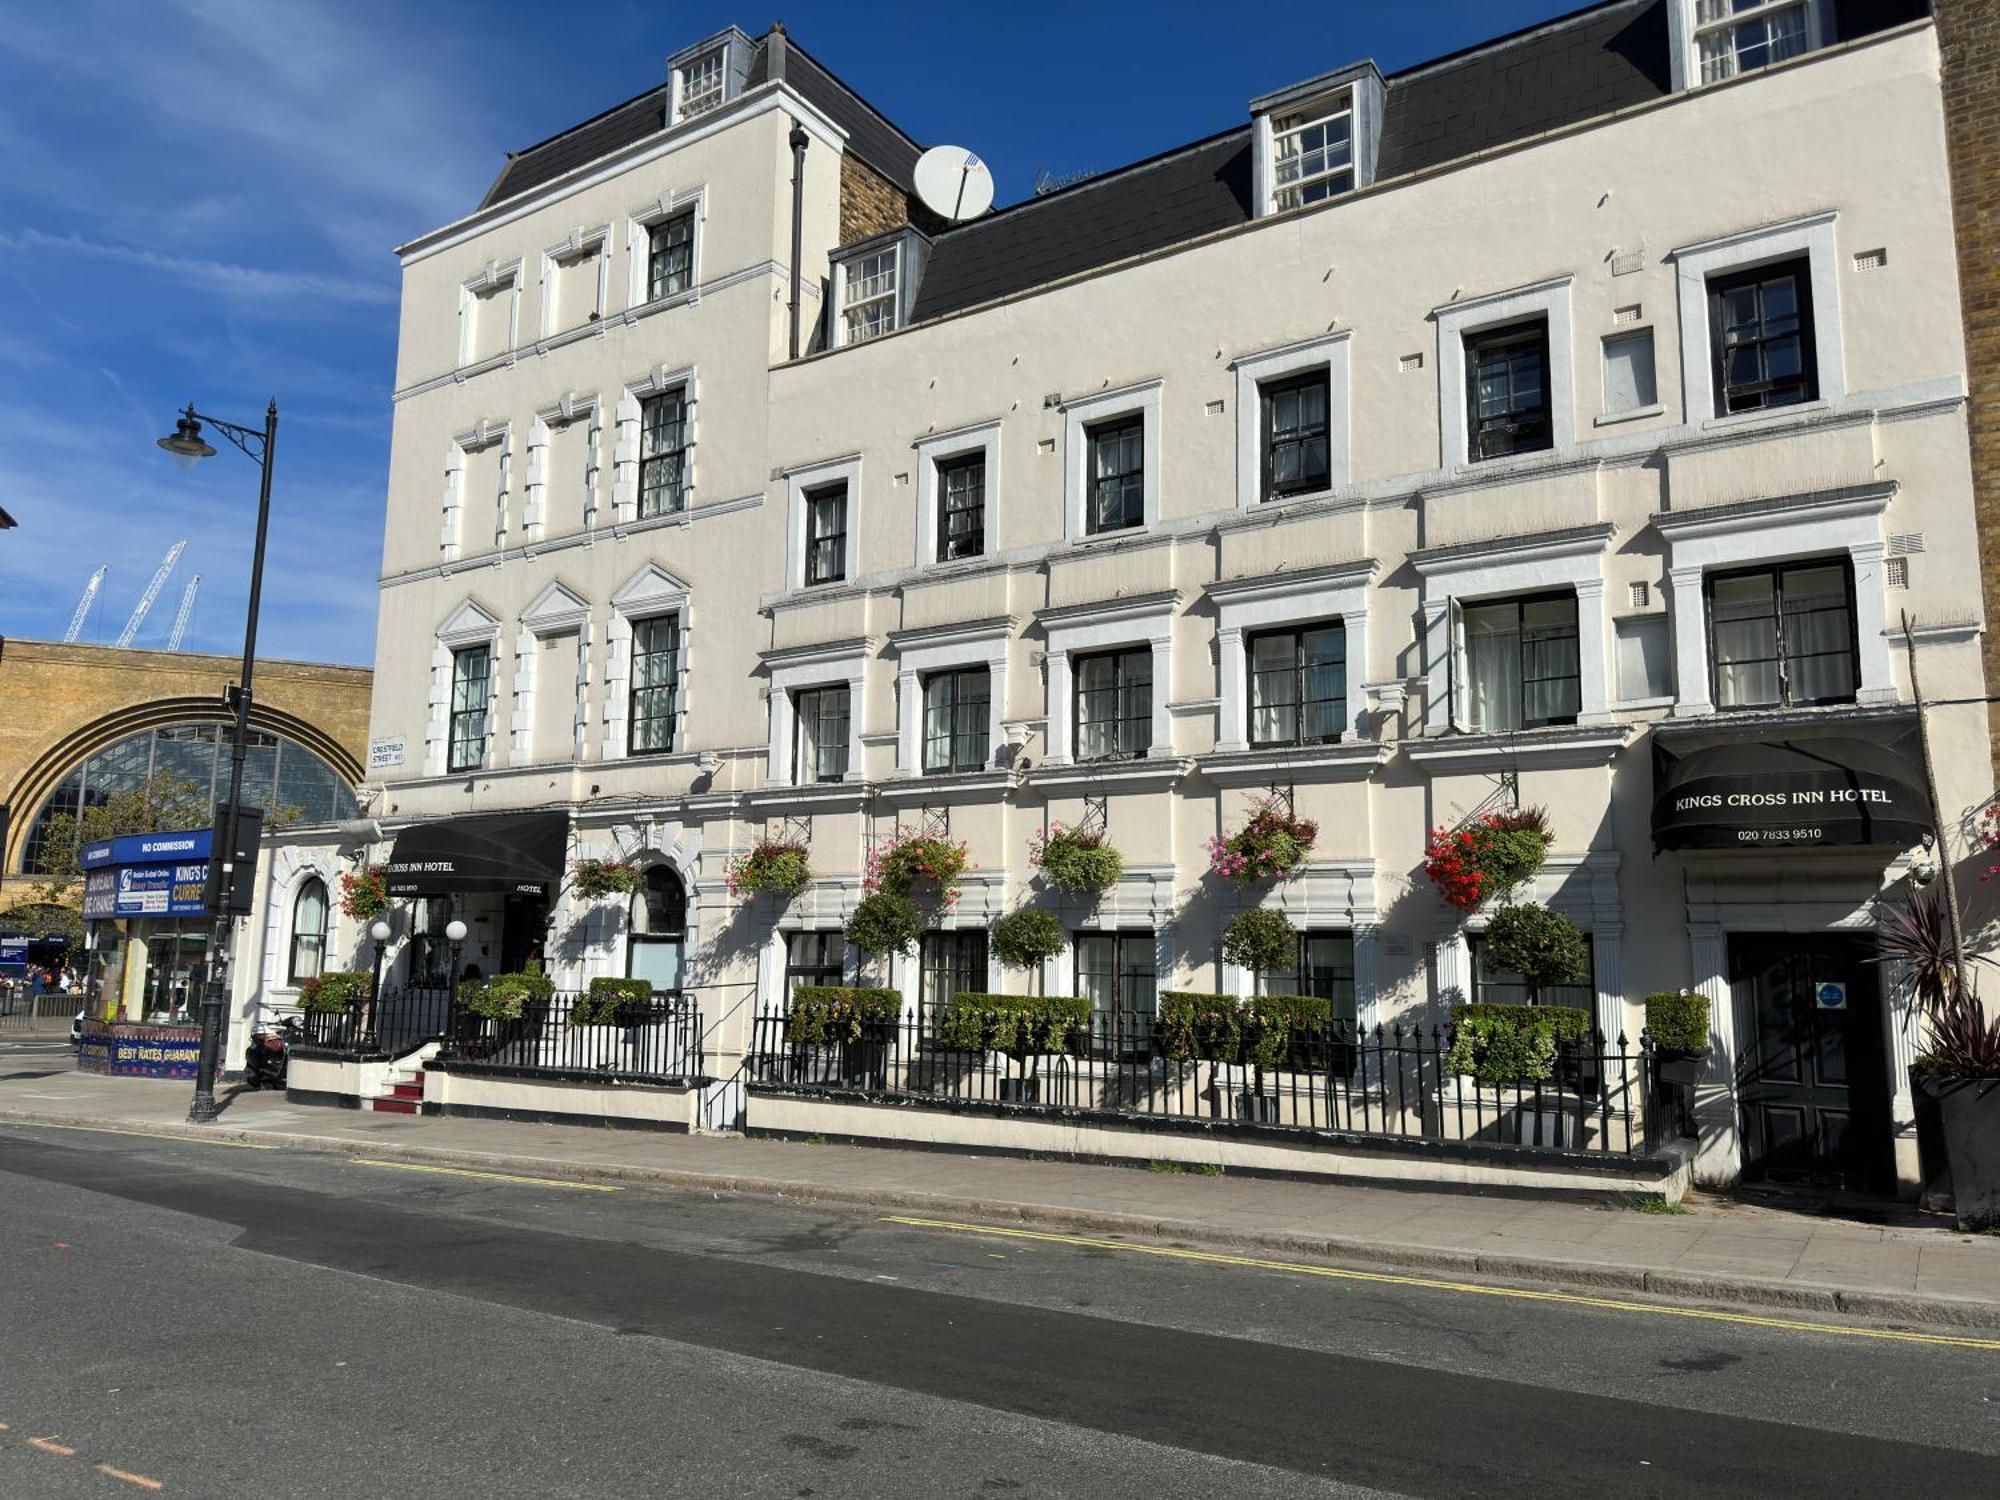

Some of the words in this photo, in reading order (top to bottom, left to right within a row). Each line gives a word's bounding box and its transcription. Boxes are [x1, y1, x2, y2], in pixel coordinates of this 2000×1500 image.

[373, 754, 392, 763] STREET
[1675, 795, 1722, 811] KINGS
[1727, 793, 1787, 806] CROSS
[1792, 791, 1824, 804] INN
[1830, 789, 1892, 804] HOTEL
[1738, 830, 1759, 841] 020
[1762, 830, 1790, 840] 7833
[1792, 828, 1822, 839] 9510
[142, 843, 151, 852] NO
[152, 840, 195, 852] COMMISSION
[176, 865, 201, 881] KING'S
[202, 865, 210, 880] C
[409, 862, 423, 872] INN
[423, 862, 455, 872] HOTEL
[173, 884, 204, 901] CURRE
[517, 884, 542, 894] HOTEL
[118, 1048, 137, 1060] BEST
[138, 1047, 161, 1061] RATES
[163, 1049, 200, 1062] GUARANT
